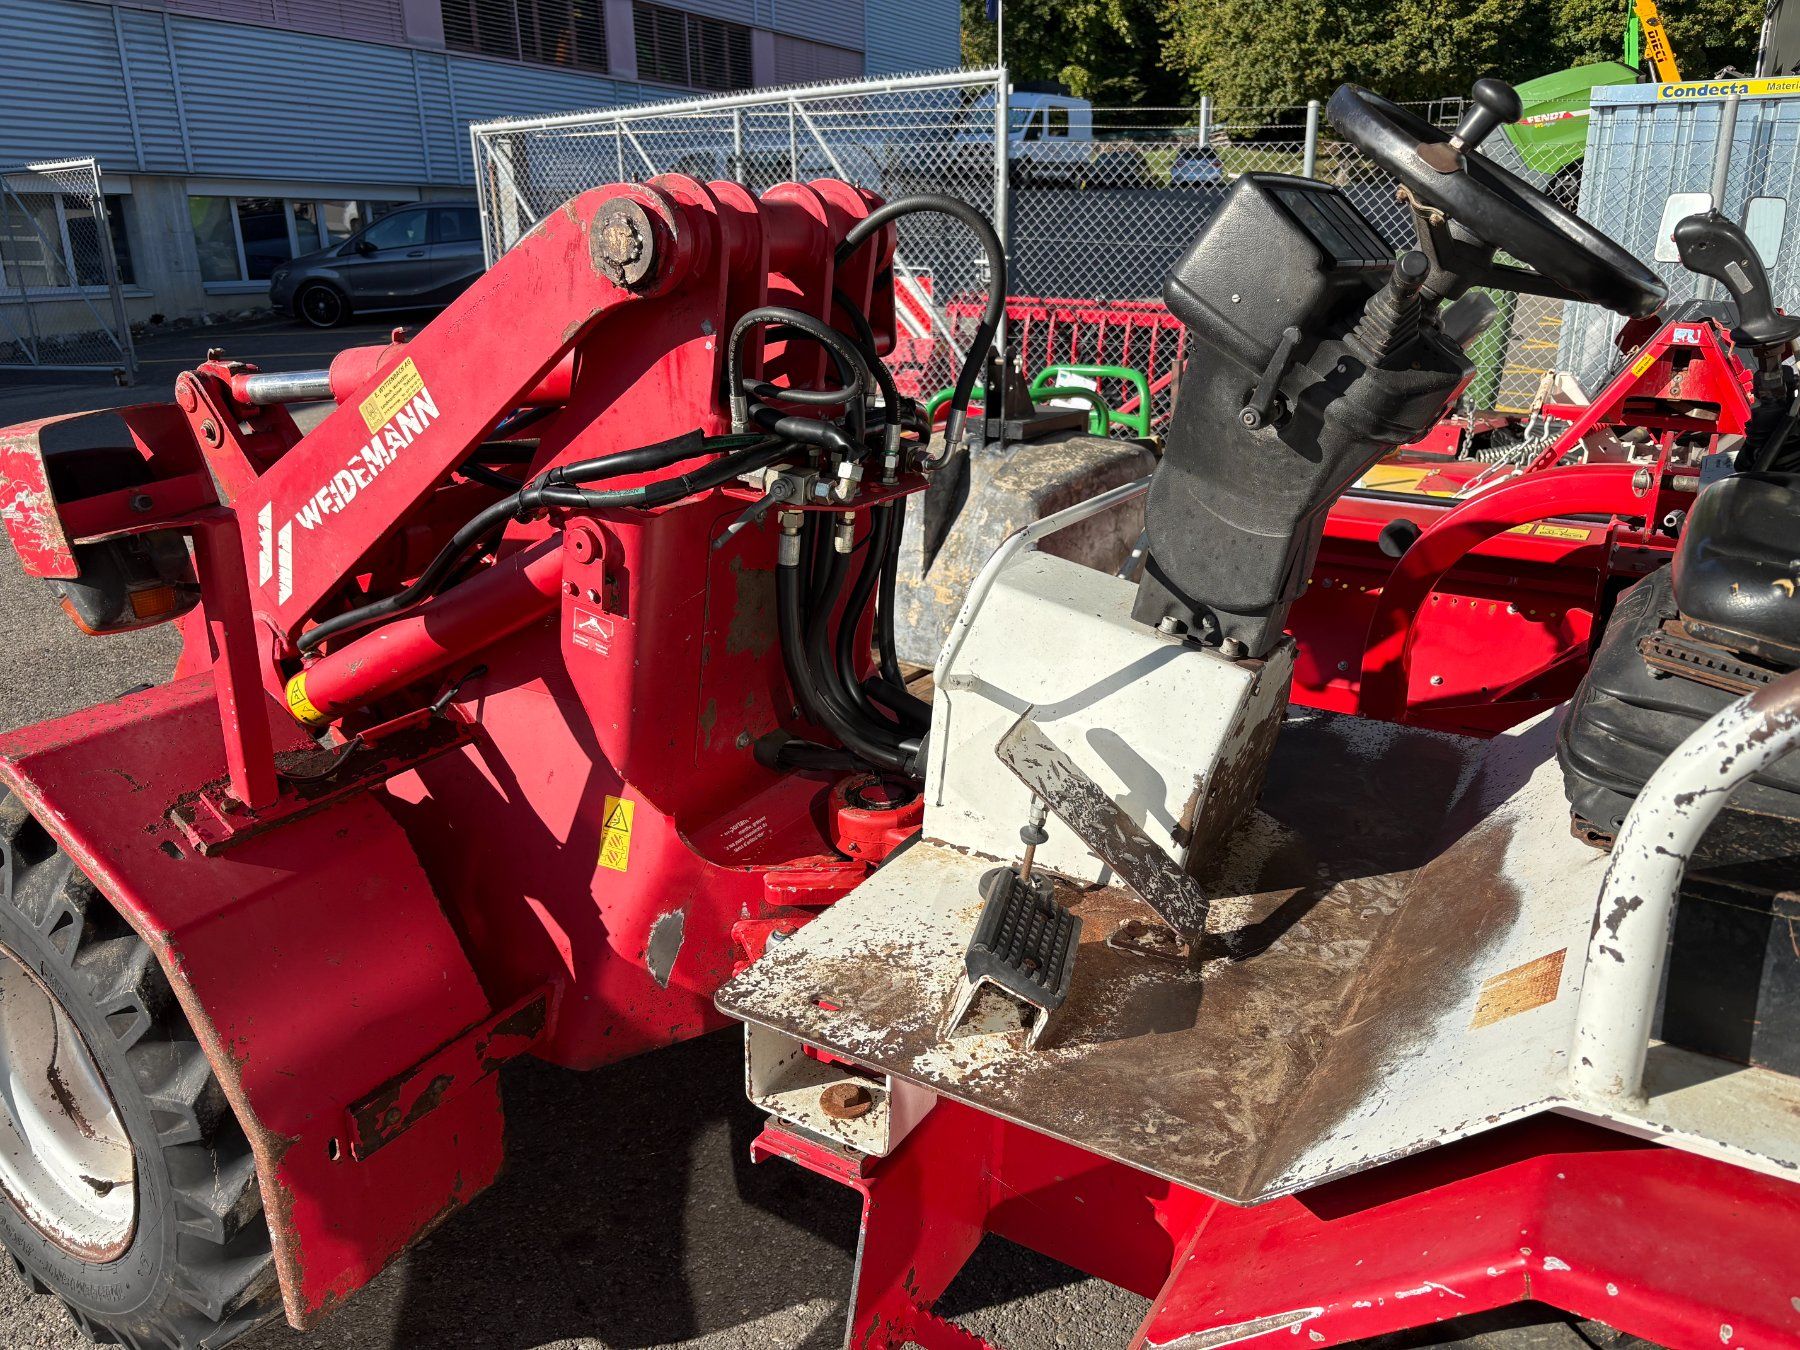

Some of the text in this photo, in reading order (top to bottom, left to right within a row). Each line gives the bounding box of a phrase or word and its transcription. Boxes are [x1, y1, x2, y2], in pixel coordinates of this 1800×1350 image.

[1662, 83, 1749, 98] Condecta
[1526, 111, 1567, 123] FENDT
[295, 386, 440, 530] WEIDEMANN
